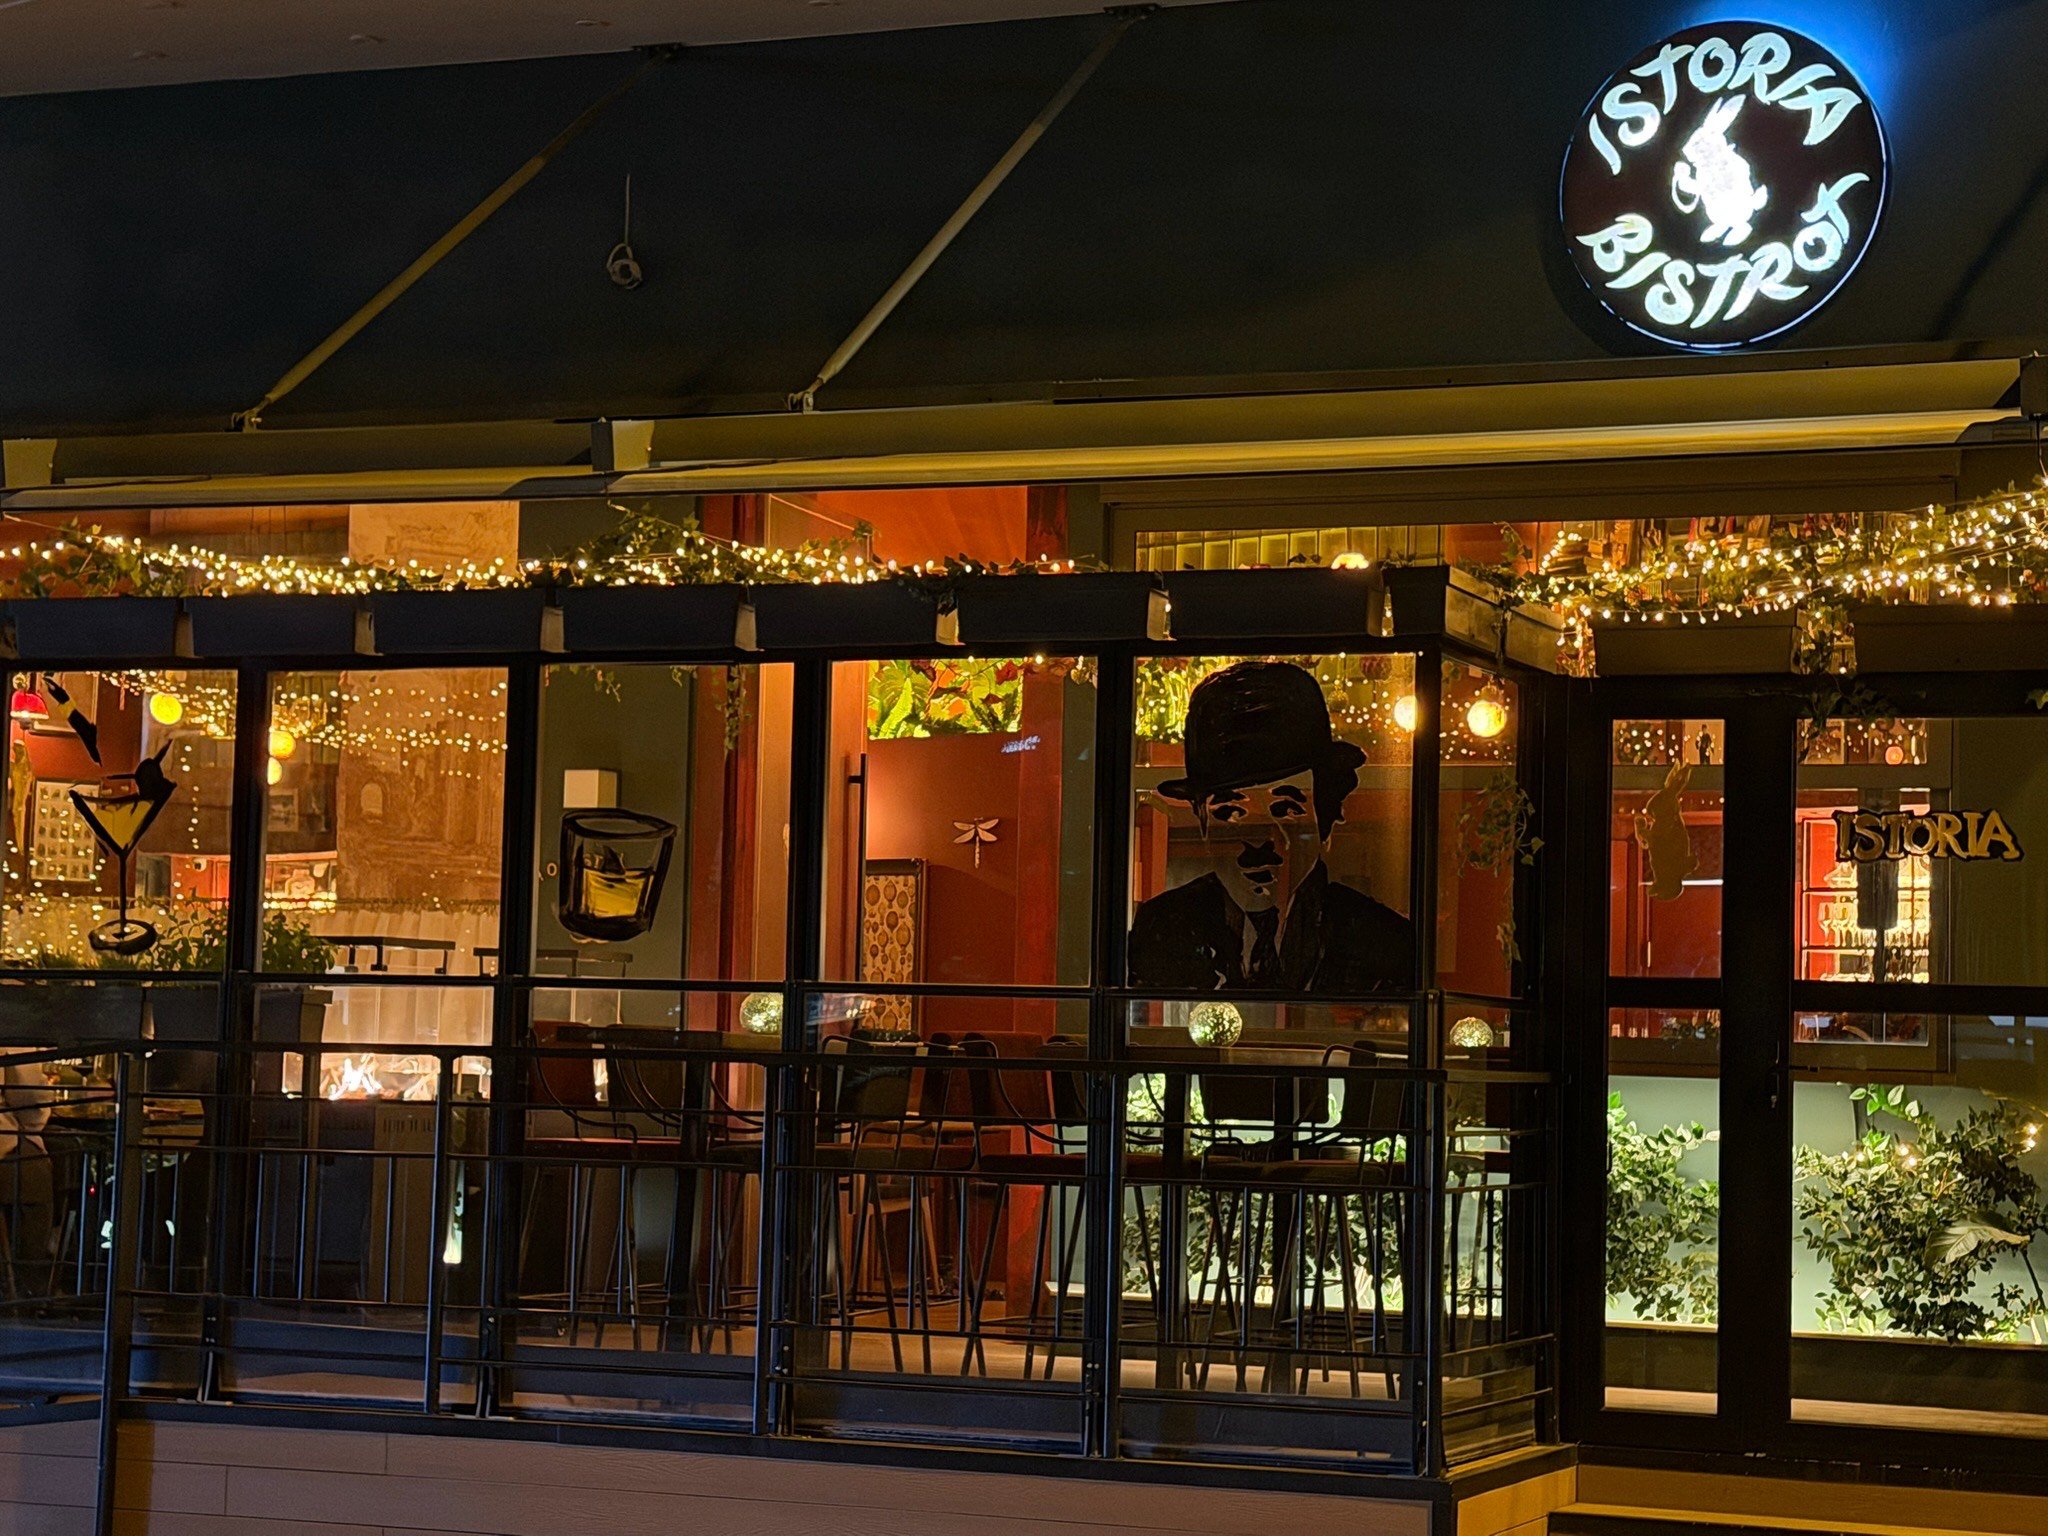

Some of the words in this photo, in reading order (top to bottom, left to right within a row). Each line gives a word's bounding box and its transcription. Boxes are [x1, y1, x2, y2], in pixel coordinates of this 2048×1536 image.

[1589, 32, 1862, 175] ISTORIA
[1576, 172, 1869, 328] BISTROT
[1838, 810, 2020, 859] ISTORIA
